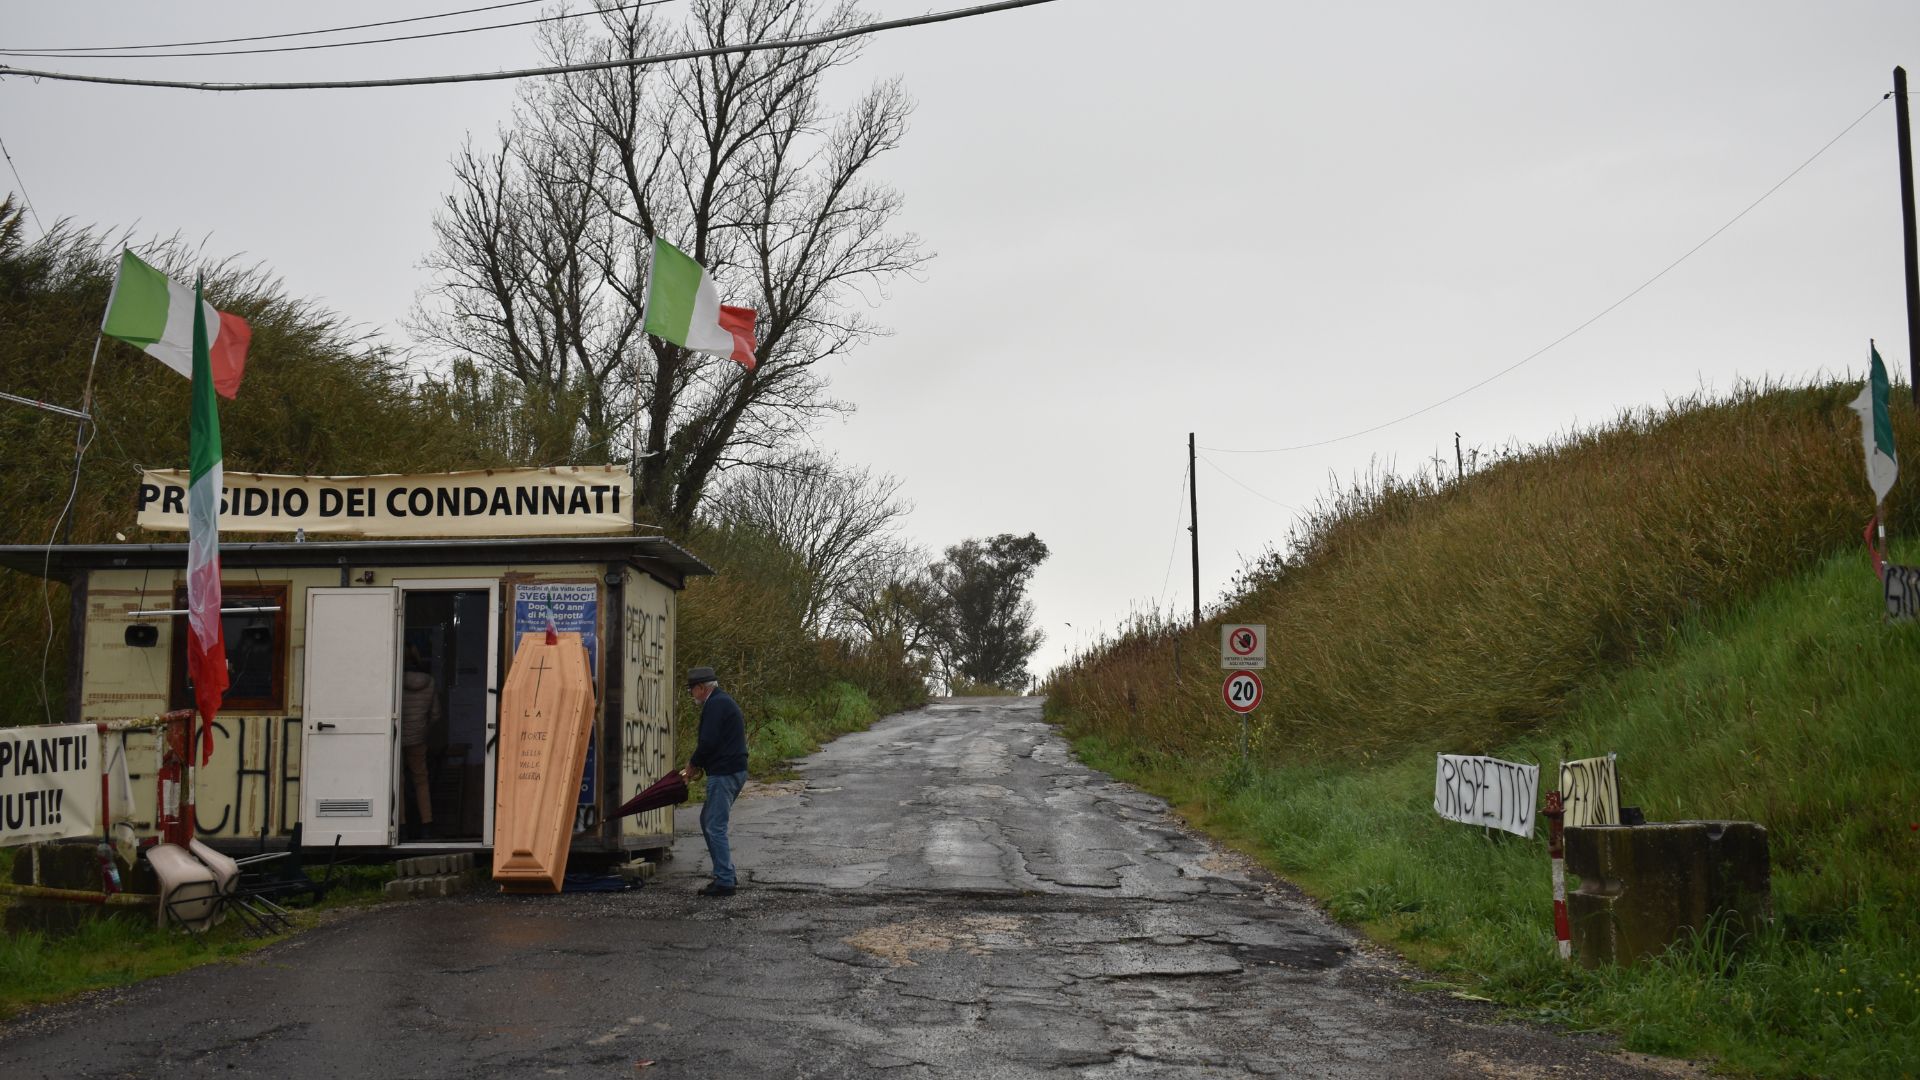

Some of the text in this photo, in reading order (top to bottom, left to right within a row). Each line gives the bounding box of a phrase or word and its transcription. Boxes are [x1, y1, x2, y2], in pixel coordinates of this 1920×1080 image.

[138, 484, 621, 517] PRSIDIO DEI CONDANNATI
[528, 602, 585, 612] Dop 40 anni
[527, 611, 536, 619] di
[1233, 681, 1254, 701] 20
[520, 731, 548, 741] MORTE
